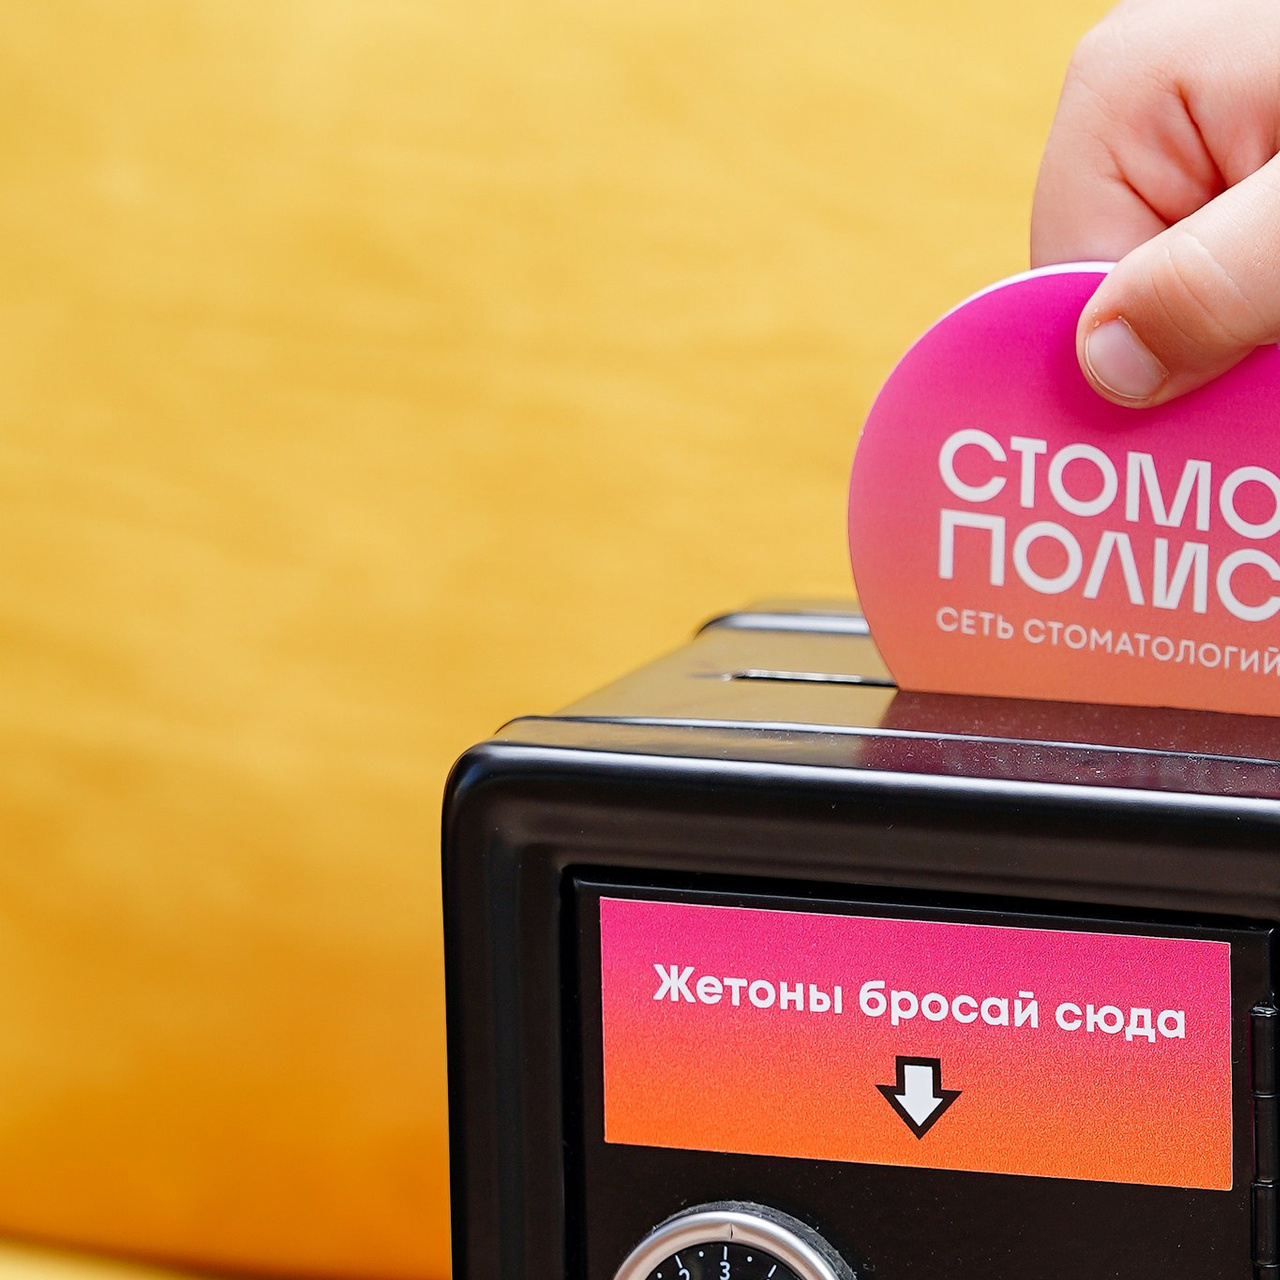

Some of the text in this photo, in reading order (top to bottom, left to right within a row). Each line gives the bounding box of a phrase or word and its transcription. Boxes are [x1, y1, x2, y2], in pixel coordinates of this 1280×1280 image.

[936, 606, 1013, 639] СЕТЬ
[652, 963, 1185, 1043] Жетоны бросай сюда
[719, 1261, 730, 1280] 3
